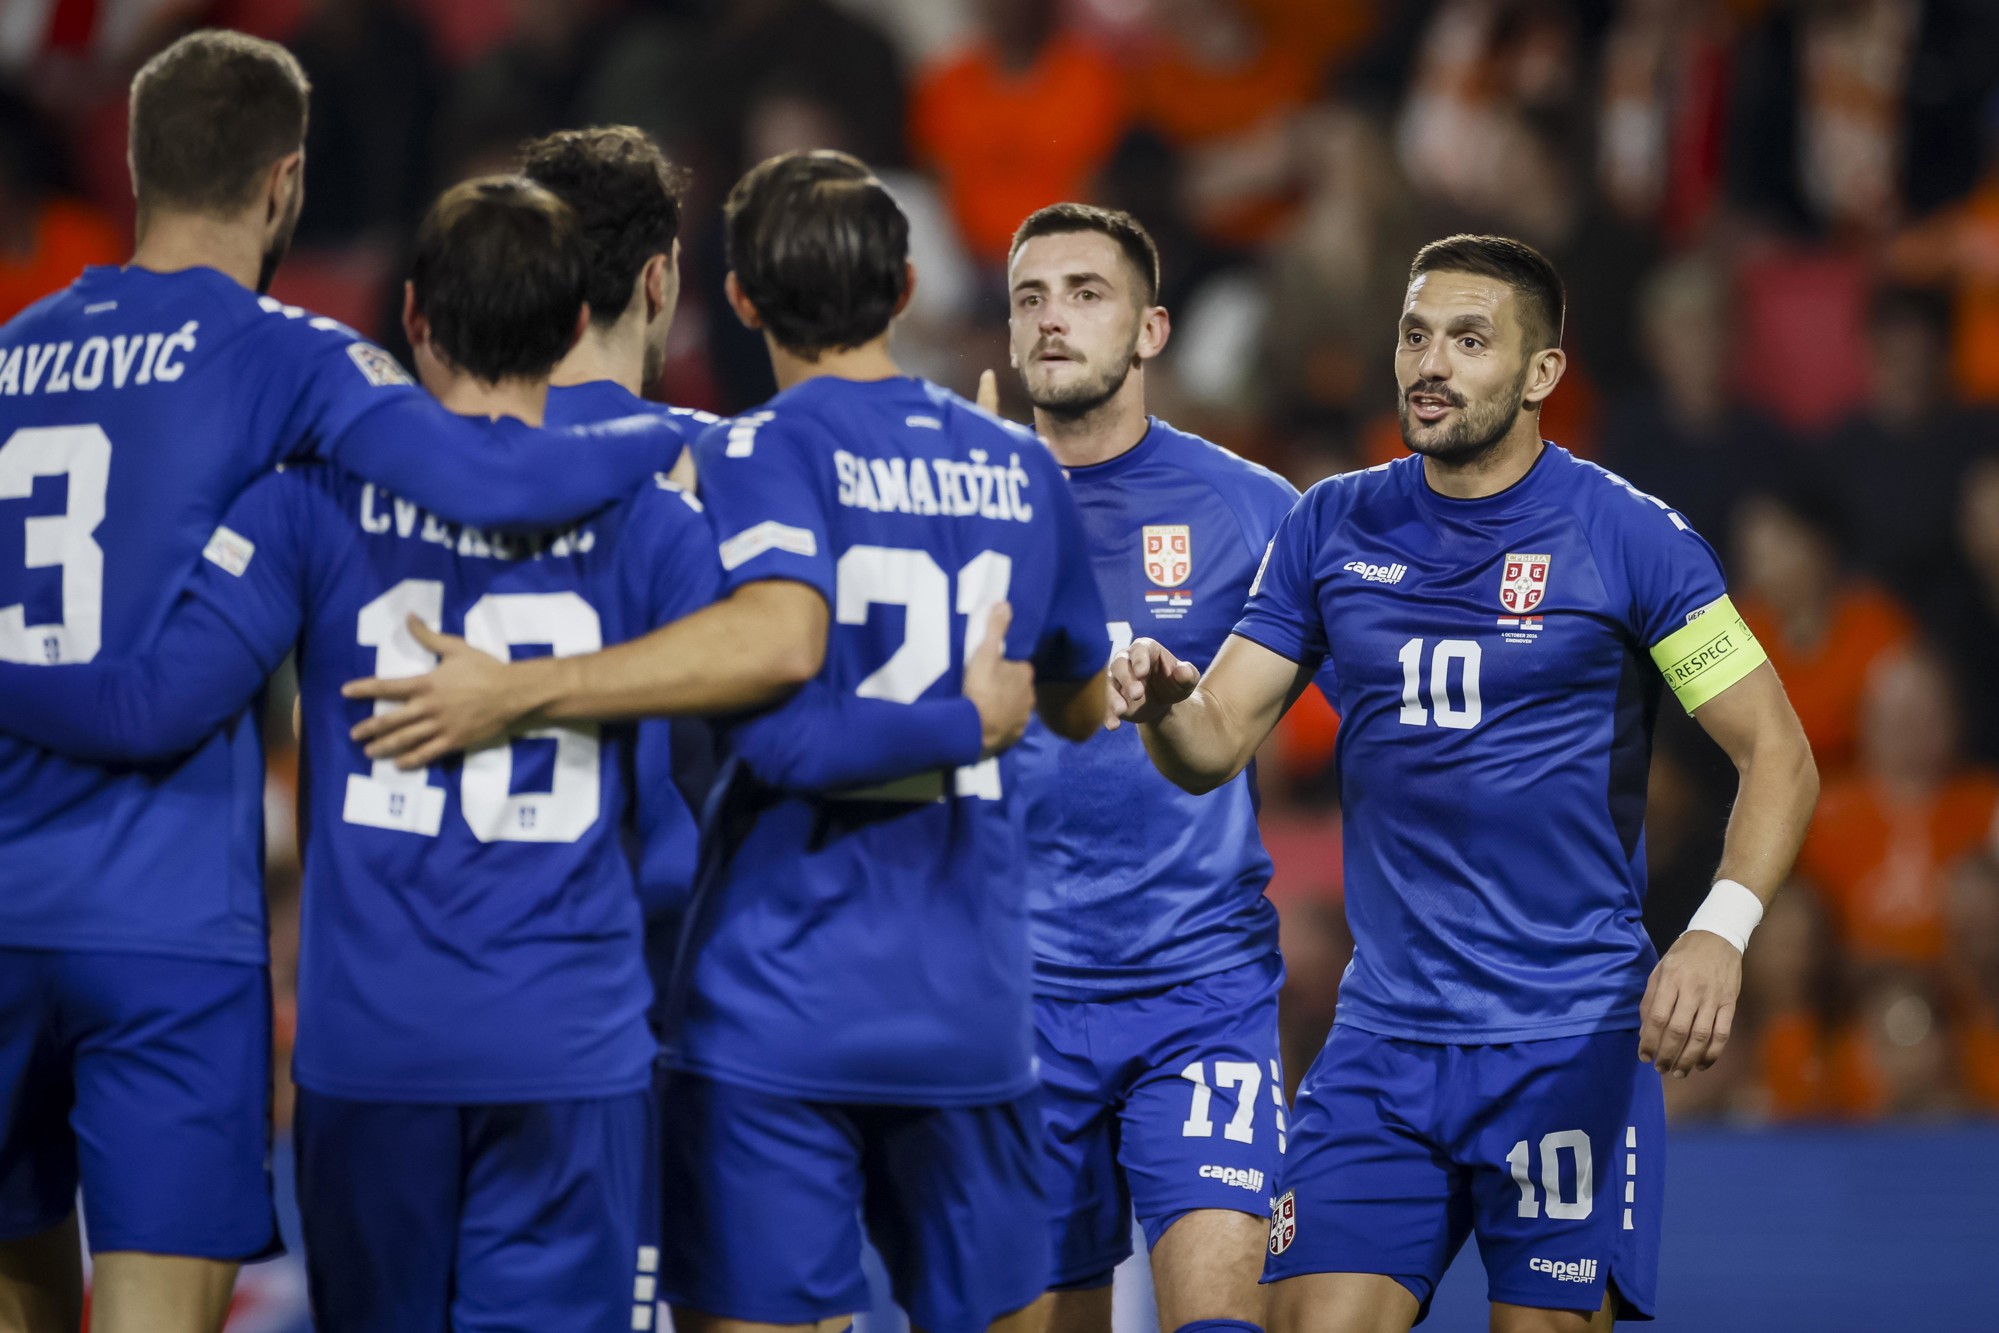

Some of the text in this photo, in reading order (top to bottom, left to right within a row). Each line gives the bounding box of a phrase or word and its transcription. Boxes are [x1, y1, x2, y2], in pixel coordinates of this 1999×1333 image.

[0, 320, 199, 395] AVLOVIĆ
[1343, 561, 1408, 580] capelli
[1674, 635, 1733, 681] RESPECT
[1397, 638, 1482, 730] 10
[1180, 1060, 1263, 1145] 17
[1199, 1165, 1264, 1188] capelli
[1228, 1180, 1261, 1193] SPORT
[1506, 1129, 1593, 1220] 10
[1529, 1257, 1598, 1278] capelli
[1558, 1274, 1595, 1284] SPORT
